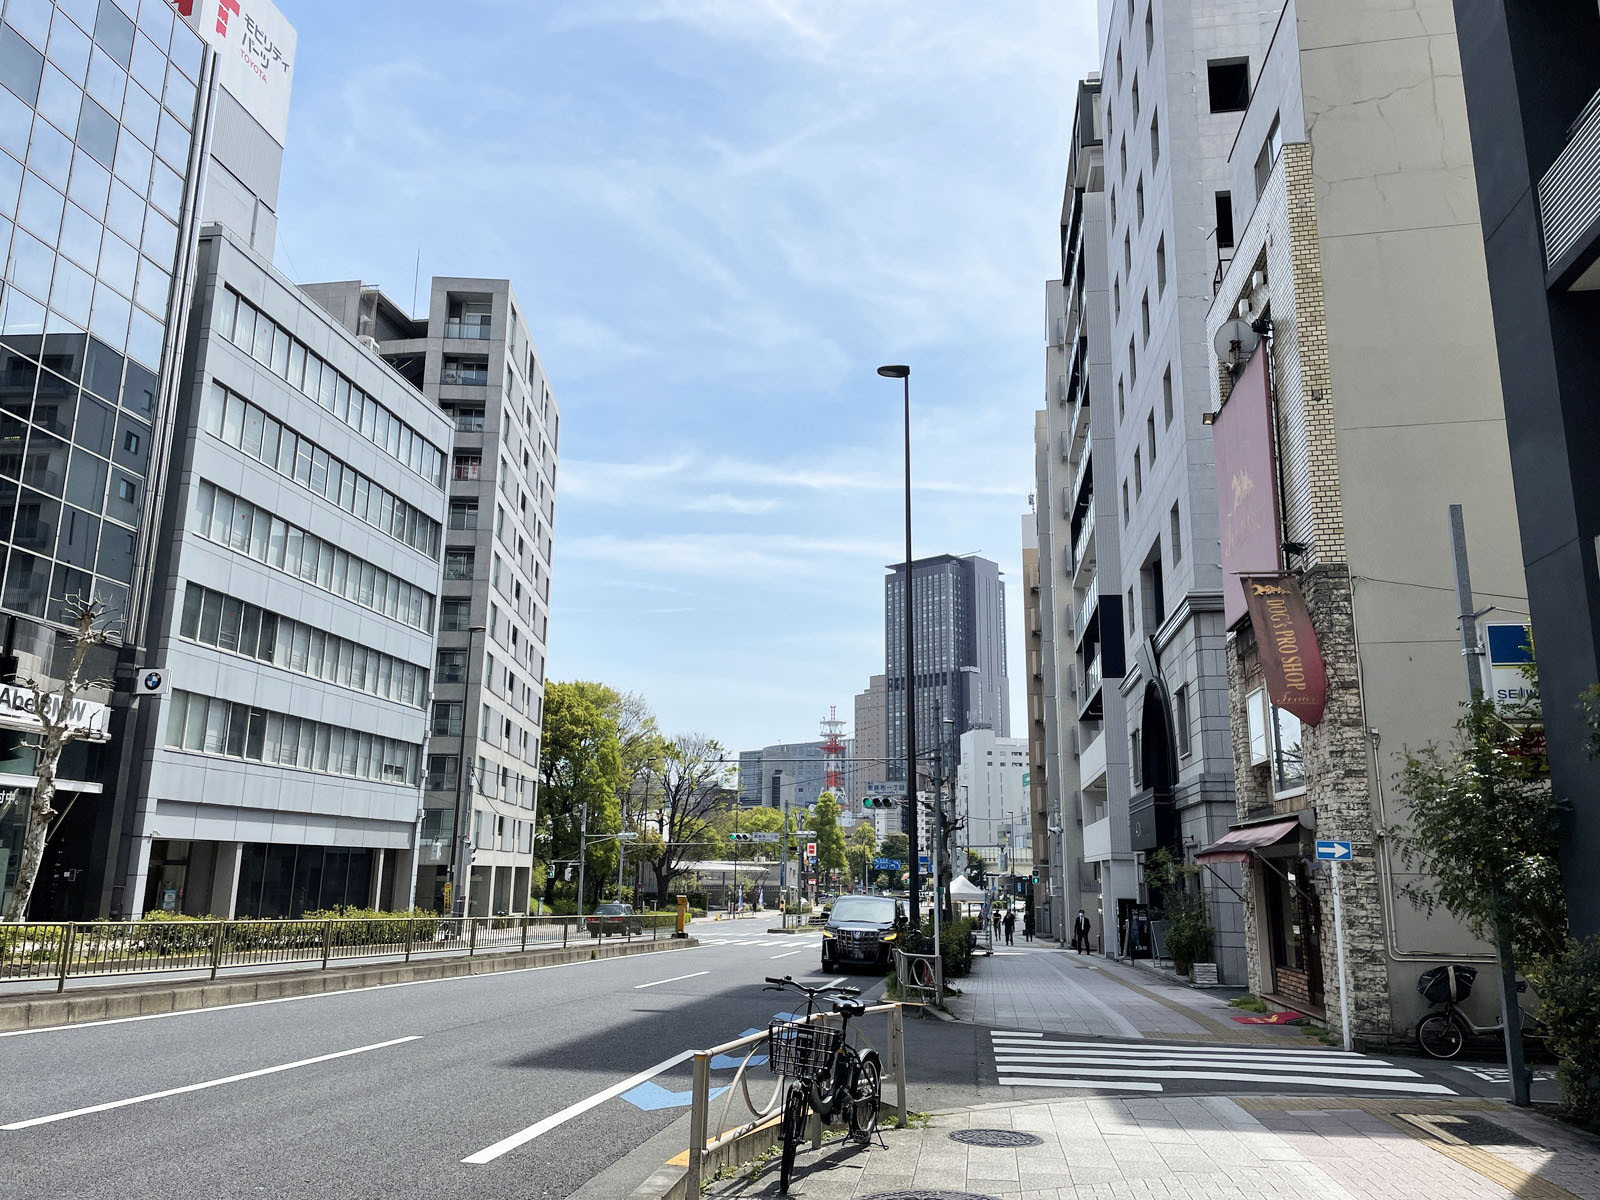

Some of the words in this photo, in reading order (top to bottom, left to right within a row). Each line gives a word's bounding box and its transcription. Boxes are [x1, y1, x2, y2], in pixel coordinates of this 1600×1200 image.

[244, 13, 290, 72] モビリティ
[240, 48, 268, 84] TOYOTA
[1275, 629, 1299, 654] PRO
[1281, 655, 1306, 691] SHOP
[0, 687, 36, 712] Abe
